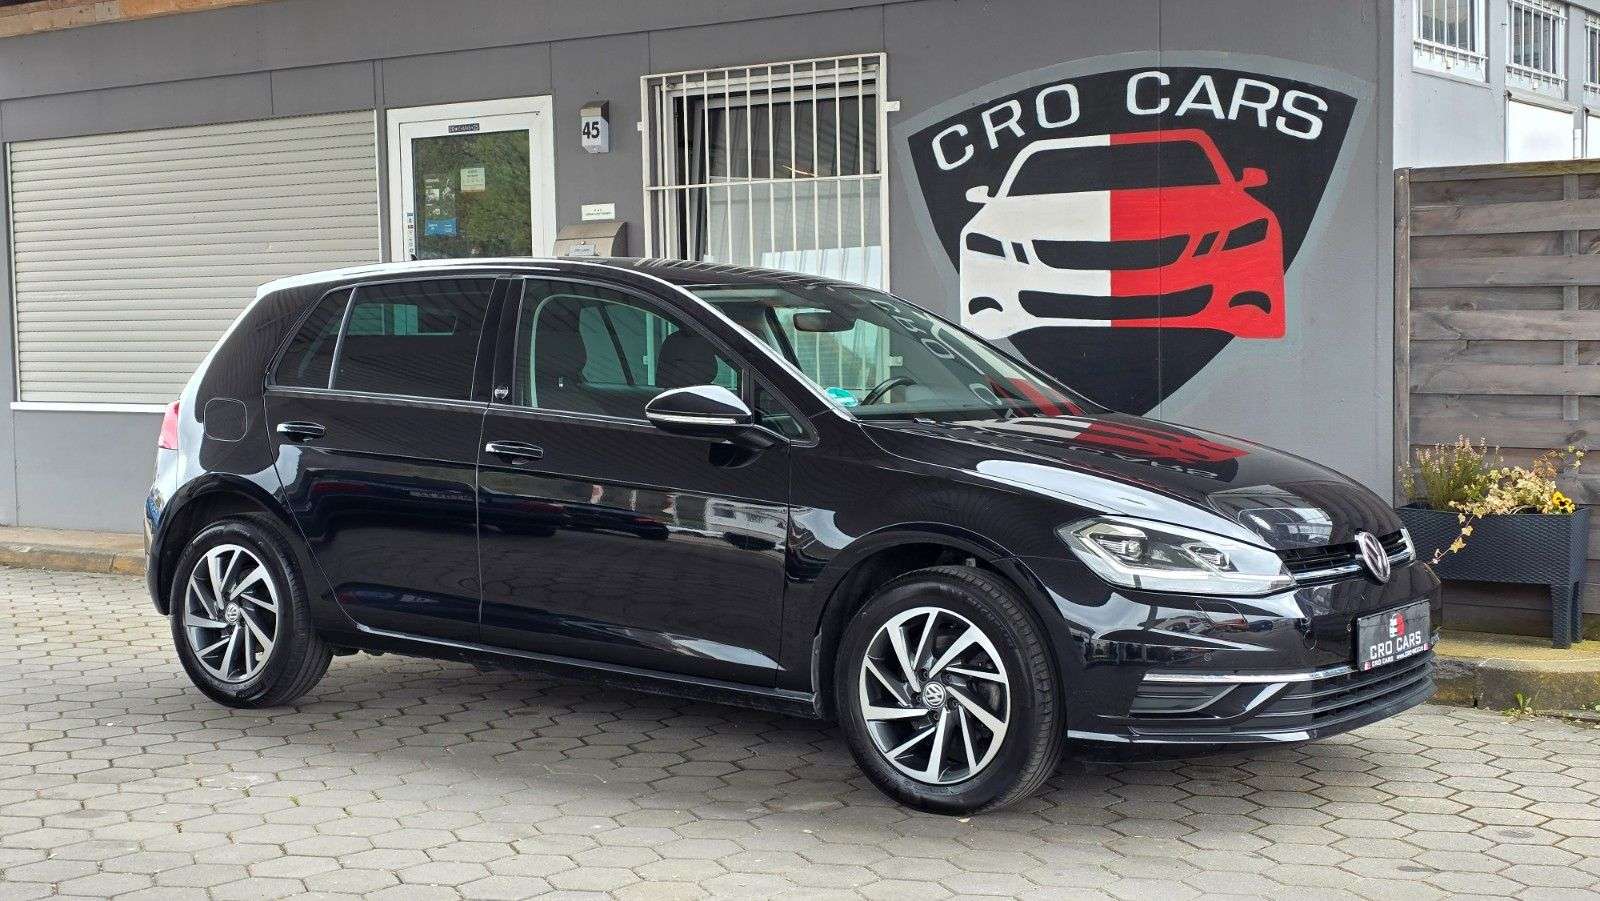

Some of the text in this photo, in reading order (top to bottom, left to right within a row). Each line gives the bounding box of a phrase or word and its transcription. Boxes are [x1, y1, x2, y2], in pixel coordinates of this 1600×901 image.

[582, 121, 600, 139] 45
[931, 70, 1329, 171] CRO CARS
[1370, 640, 1393, 660] CRO
[1396, 630, 1422, 652] CARS
